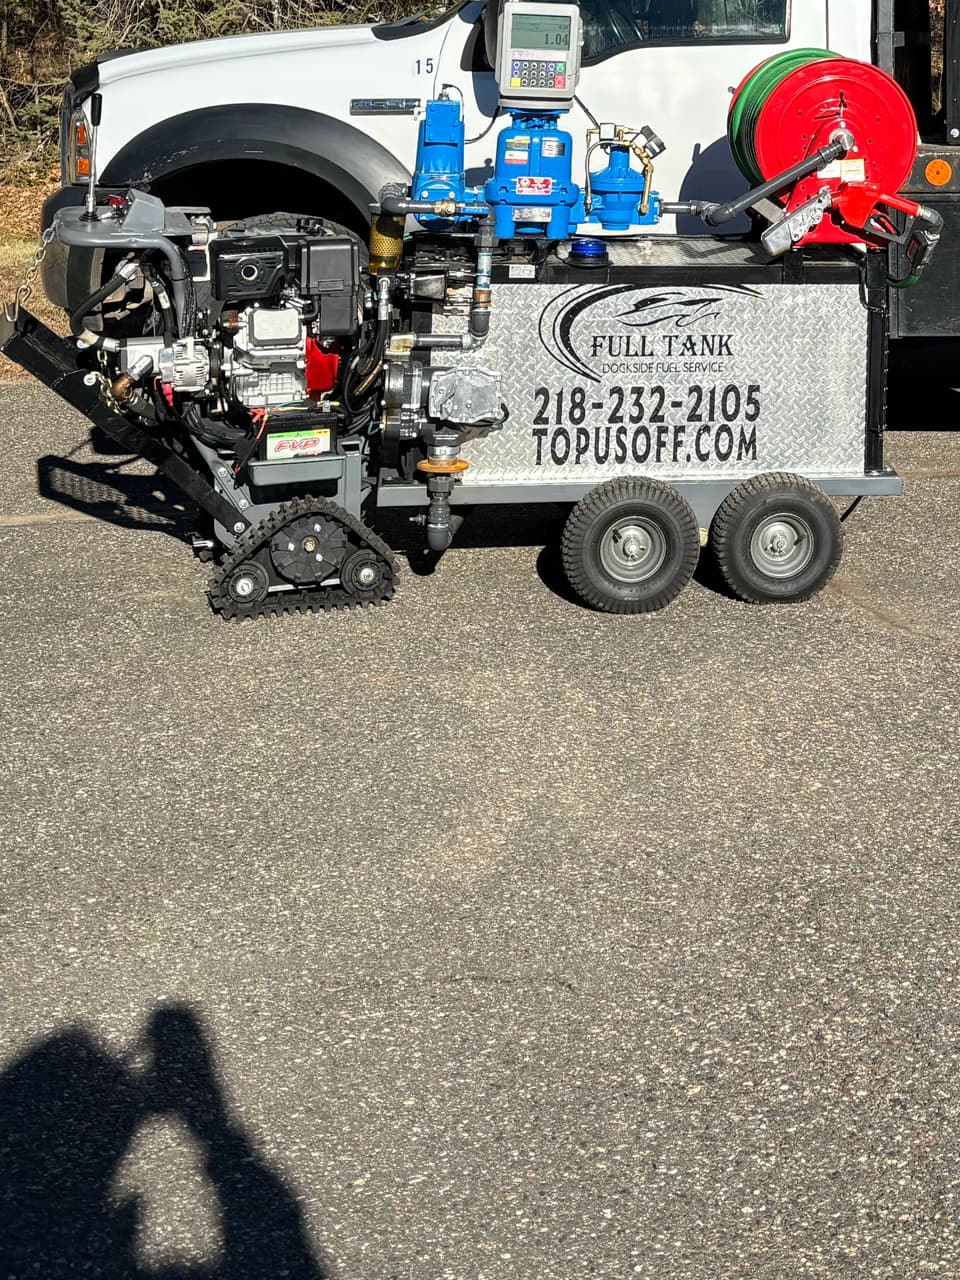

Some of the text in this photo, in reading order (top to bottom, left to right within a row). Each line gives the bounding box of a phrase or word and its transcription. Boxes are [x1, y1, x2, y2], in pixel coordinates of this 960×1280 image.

[590, 334, 735, 357] FULL TANK
[602, 361, 724, 374] DOCKSIDE FUEL SERVICE
[533, 384, 761, 426] 218-232-2105
[532, 424, 758, 466] TOPUSOFF.COM
